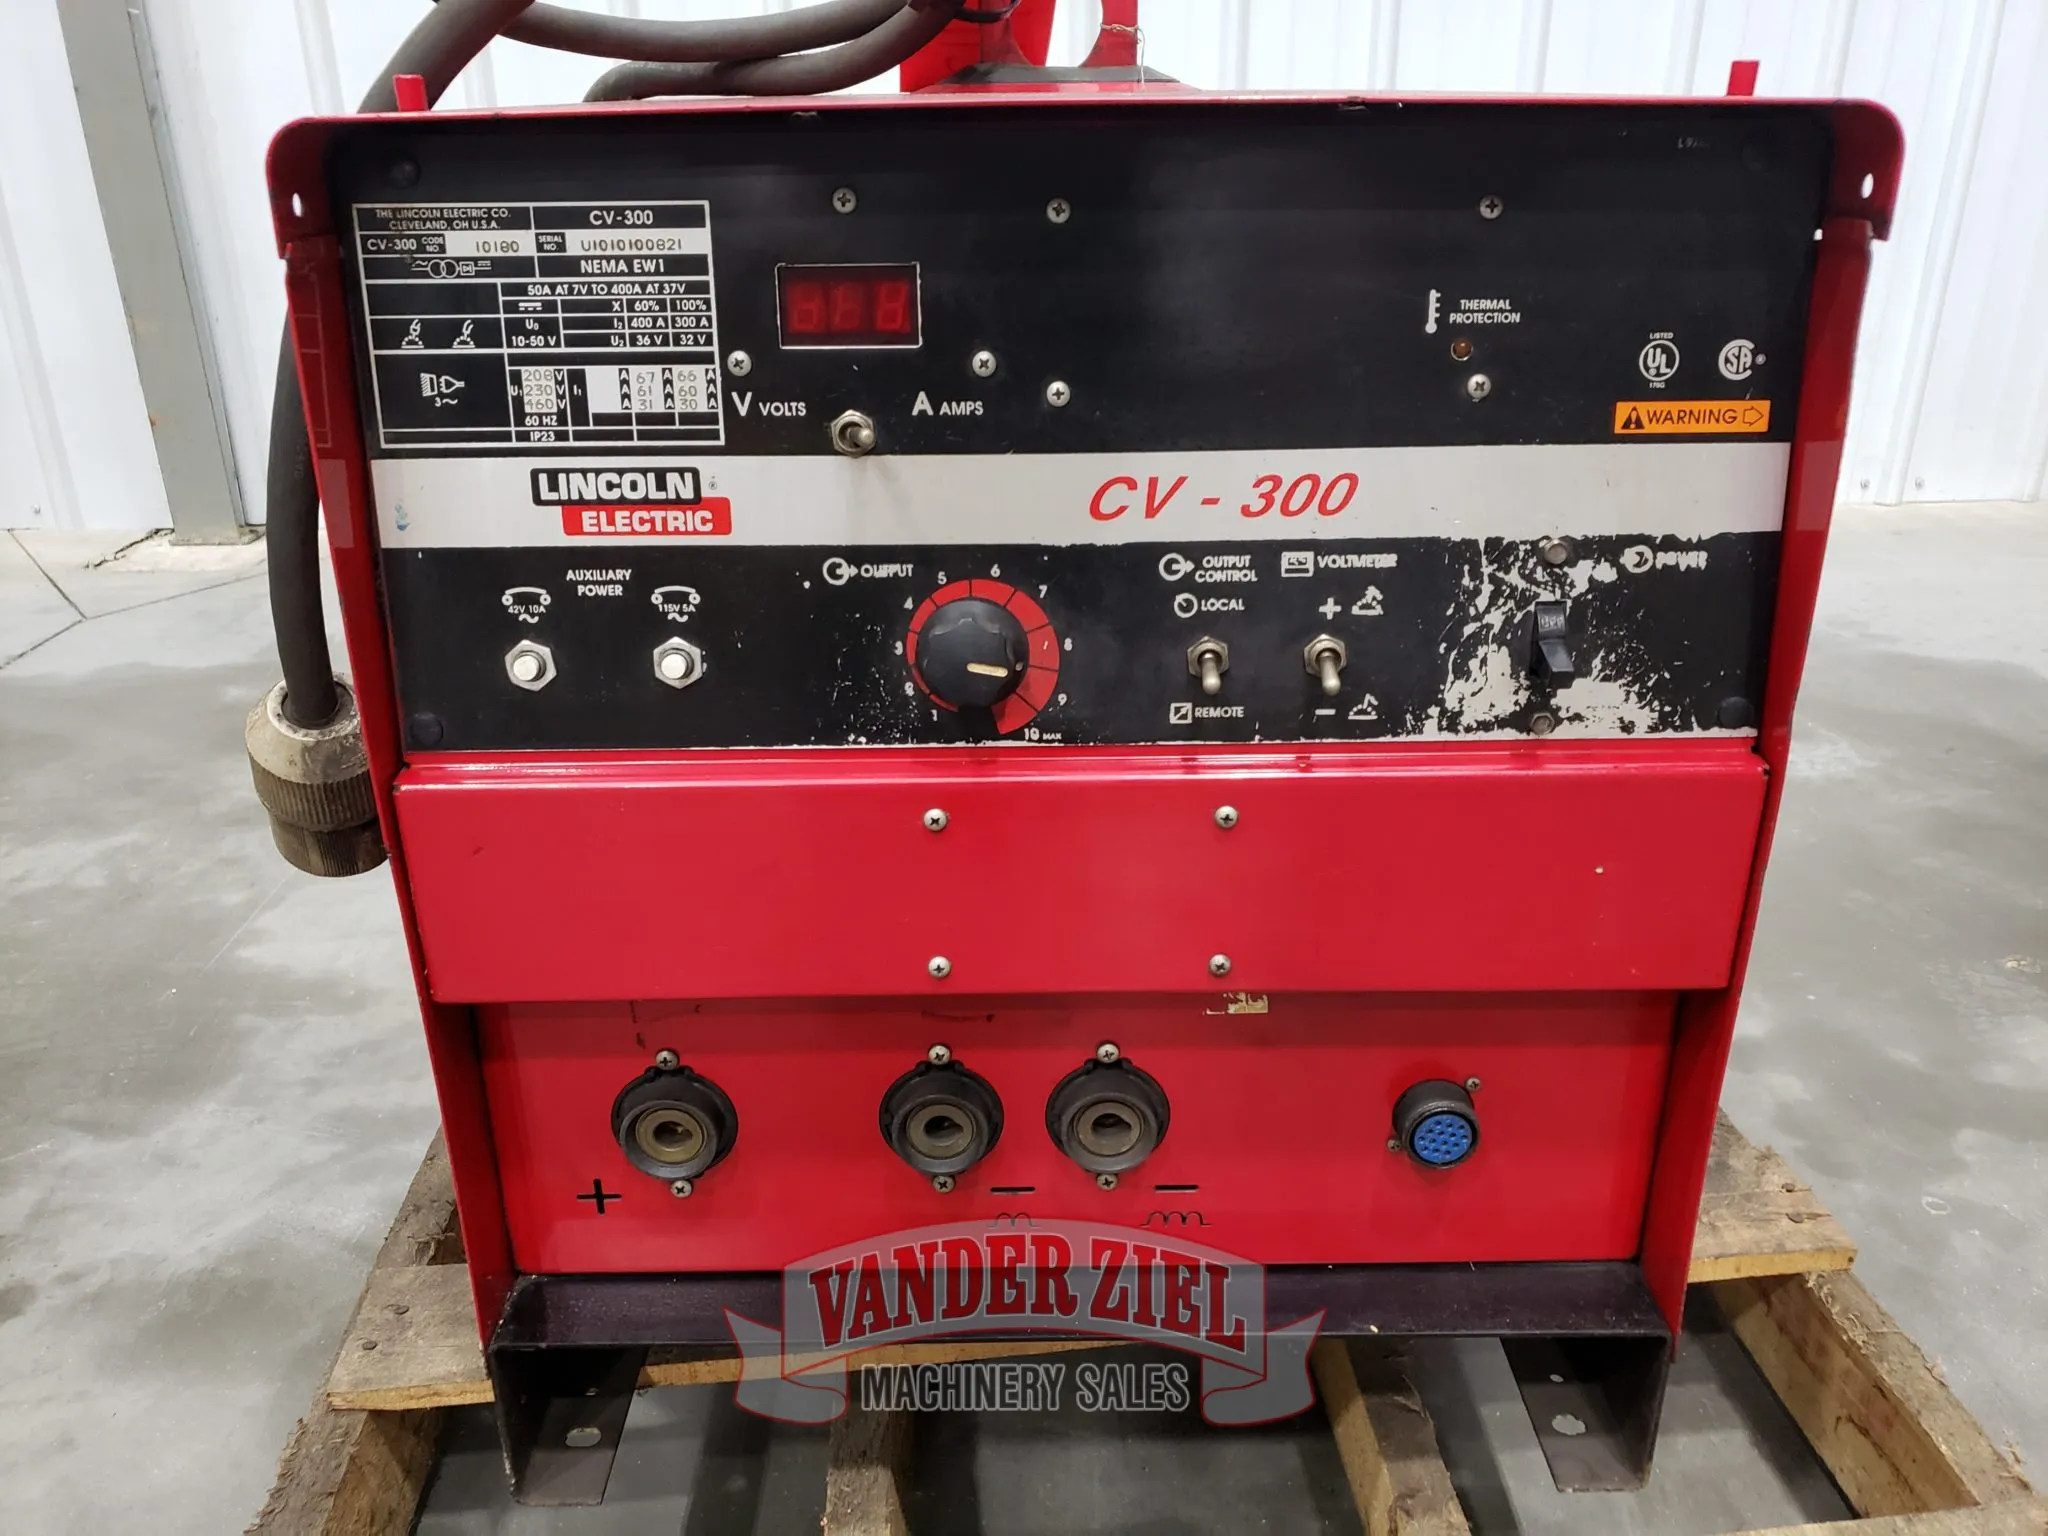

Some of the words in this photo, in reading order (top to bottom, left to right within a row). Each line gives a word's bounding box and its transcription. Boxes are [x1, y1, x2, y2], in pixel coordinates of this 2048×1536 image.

[376, 209, 393, 218] THE
[397, 209, 441, 218] LINCOLN
[444, 208, 488, 218] ELECTRIC
[491, 208, 511, 218] CO.
[589, 210, 654, 225] CV-300
[453, 220, 469, 230] OH
[421, 237, 444, 245] CODE
[538, 235, 563, 243] SERIAL
[367, 239, 417, 251] CV-300
[476, 241, 520, 253] 10180
[580, 260, 629, 274] NEMA
[633, 259, 665, 273] EW1
[528, 285, 551, 295] 50A
[555, 285, 569, 295] AT
[572, 284, 588, 295] 7V
[592, 284, 607, 295] TO
[611, 284, 642, 295] 400A
[646, 284, 660, 294] AT
[663, 284, 686, 294] 37V
[612, 301, 621, 312] X
[634, 301, 659, 311] 60%
[677, 301, 707, 311] 100%
[1460, 299, 1512, 310] THERMAL
[631, 318, 653, 328] 400
[656, 318, 666, 328] A
[675, 317, 696, 328] 300
[700, 317, 709, 328] A
[1450, 312, 1521, 324] PROTECTION
[512, 336, 545, 347] 10-50
[547, 336, 557, 346] V
[636, 335, 650, 346] 36
[653, 335, 663, 346] V
[680, 335, 694, 345] 32
[697, 335, 707, 345] V
[523, 370, 553, 381] 208
[555, 370, 564, 381] V
[620, 370, 629, 380] A
[636, 372, 655, 384] 67
[663, 370, 673, 380] A
[677, 370, 697, 382] 66
[707, 369, 716, 380] A
[525, 385, 553, 396] 230
[556, 385, 565, 396] V
[621, 385, 630, 395] A
[638, 385, 653, 397] 61
[665, 384, 674, 395] A
[679, 385, 698, 397] 60
[708, 384, 717, 394] A
[526, 399, 554, 410] 460
[558, 399, 567, 409] V
[623, 399, 632, 409] A
[666, 399, 675, 409] A
[680, 399, 698, 410] 30
[709, 399, 718, 409] A
[732, 392, 752, 417] V
[759, 402, 807, 416] VOLTS
[912, 392, 934, 416] A
[940, 401, 984, 416] AMPS
[525, 416, 539, 426] 60
[543, 415, 558, 426] HZ
[1647, 409, 1737, 425] WARNING
[530, 431, 555, 442] IP23
[538, 472, 695, 500] LINCOLN
[1089, 476, 1189, 521] CV
[1240, 473, 1360, 519] 300
[582, 510, 714, 533] ELECTRIC
[1202, 555, 1251, 568] OUTPUT
[566, 569, 632, 581] AUXILIARY
[991, 564, 1000, 577] 6
[938, 572, 947, 585] 5
[1195, 570, 1258, 583] CONTROL
[578, 585, 623, 596] POWER
[1039, 585, 1048, 599] 7
[659, 604, 680, 613] 115V
[683, 604, 696, 613] 5A
[904, 597, 913, 610] 4
[1201, 598, 1245, 612] LOCAL
[508, 605, 525, 614] 42V
[529, 605, 546, 614] 10A
[1058, 694, 1067, 706] 9
[1195, 707, 1245, 718] REMOTE
[1024, 727, 1040, 741] 10
